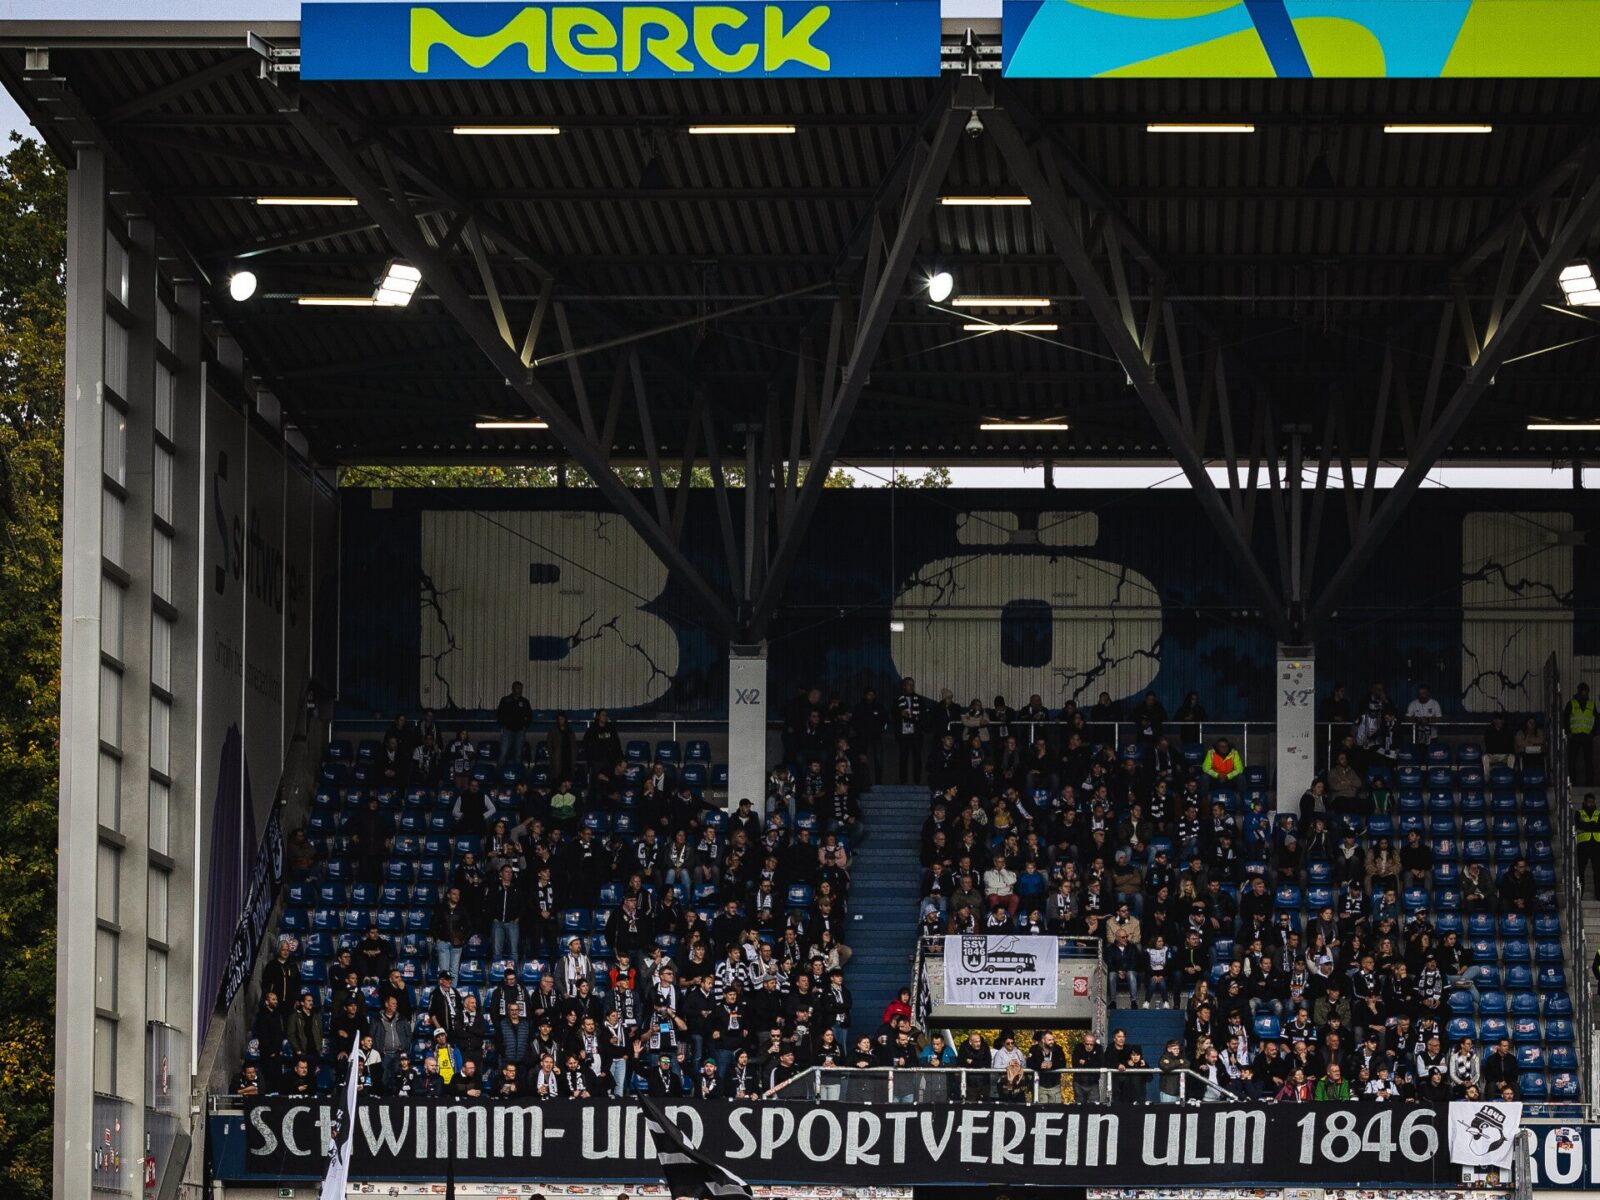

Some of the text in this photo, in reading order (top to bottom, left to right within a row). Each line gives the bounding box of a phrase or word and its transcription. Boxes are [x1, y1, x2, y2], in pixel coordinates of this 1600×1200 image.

[735, 689, 760, 705] X2
[963, 948, 986, 956] 1846
[956, 977, 1046, 986] SPATZENFAHRT
[979, 992, 1030, 1000] ON TOUR
[1482, 1106, 1503, 1122] 1846
[725, 1106, 1120, 1168] SPORTVEREIN
[1141, 1109, 1266, 1167] ULM
[1297, 1108, 1439, 1165] 1846
